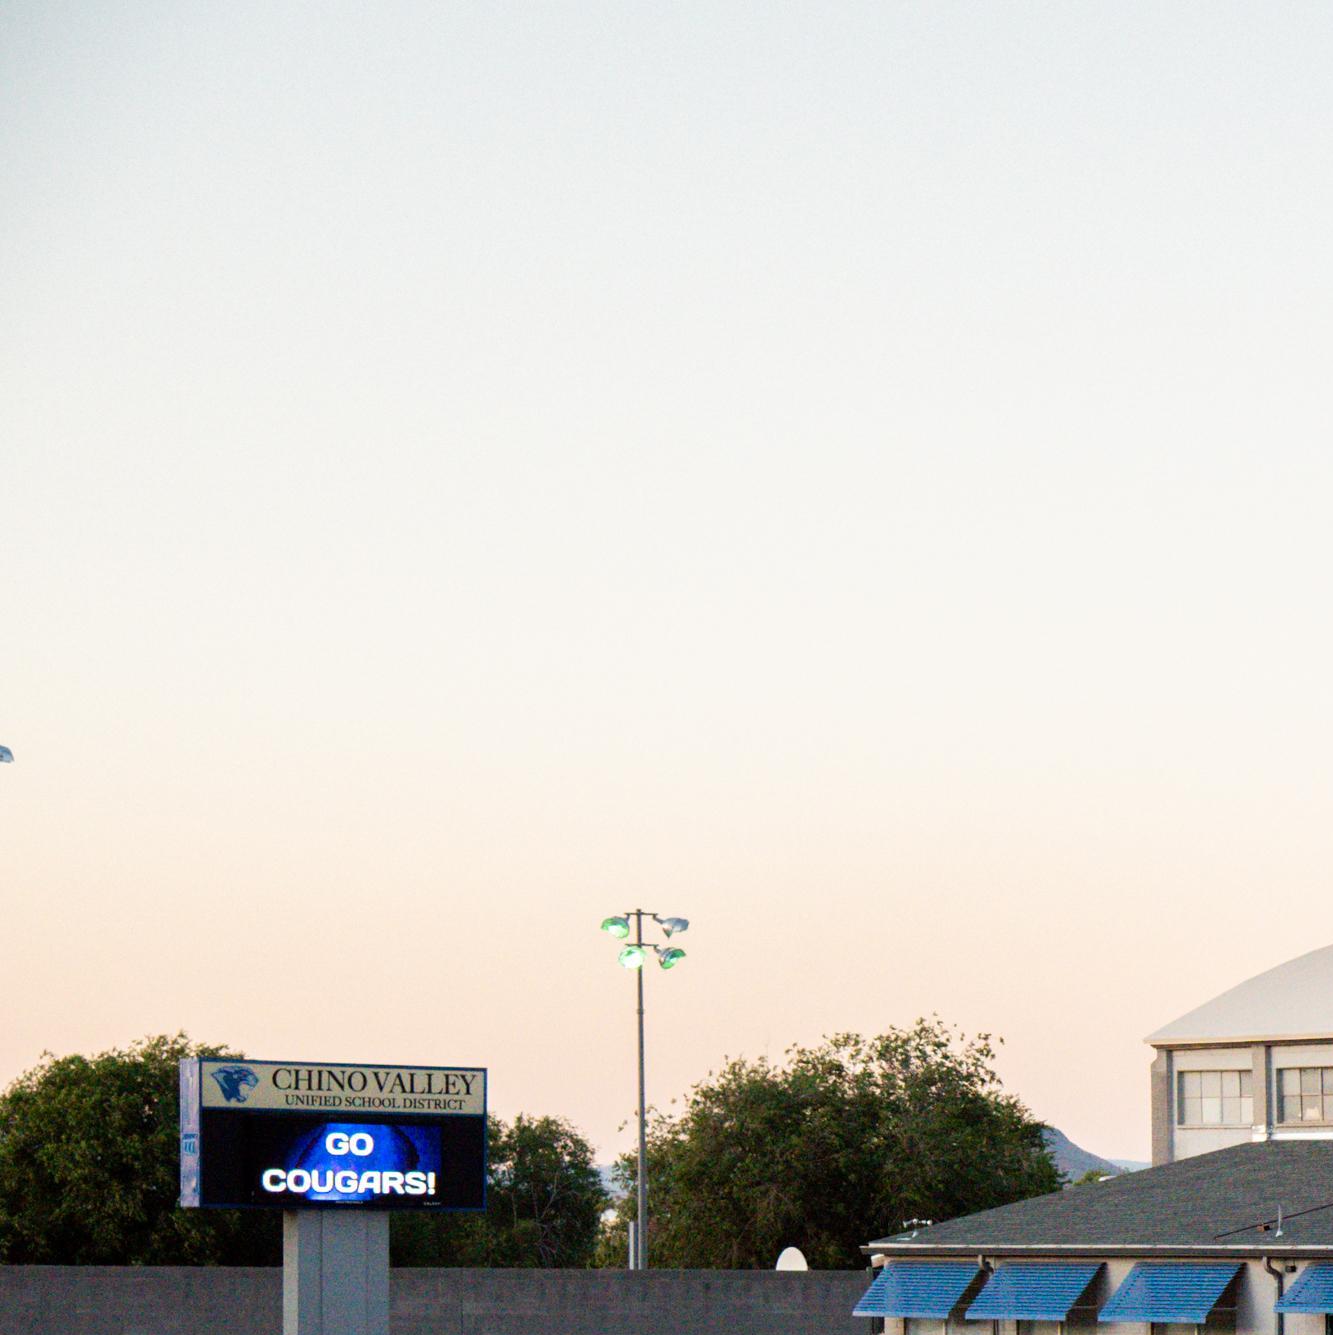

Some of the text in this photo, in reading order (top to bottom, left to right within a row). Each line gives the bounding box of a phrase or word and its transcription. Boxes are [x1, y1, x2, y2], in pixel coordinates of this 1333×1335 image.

[272, 1068, 477, 1096] CHINO VALLEY
[285, 1094, 466, 1110] UNIFIED SCHOOL DISTRICT
[325, 1132, 374, 1156] GO
[262, 1168, 436, 1195] COUGARS!
